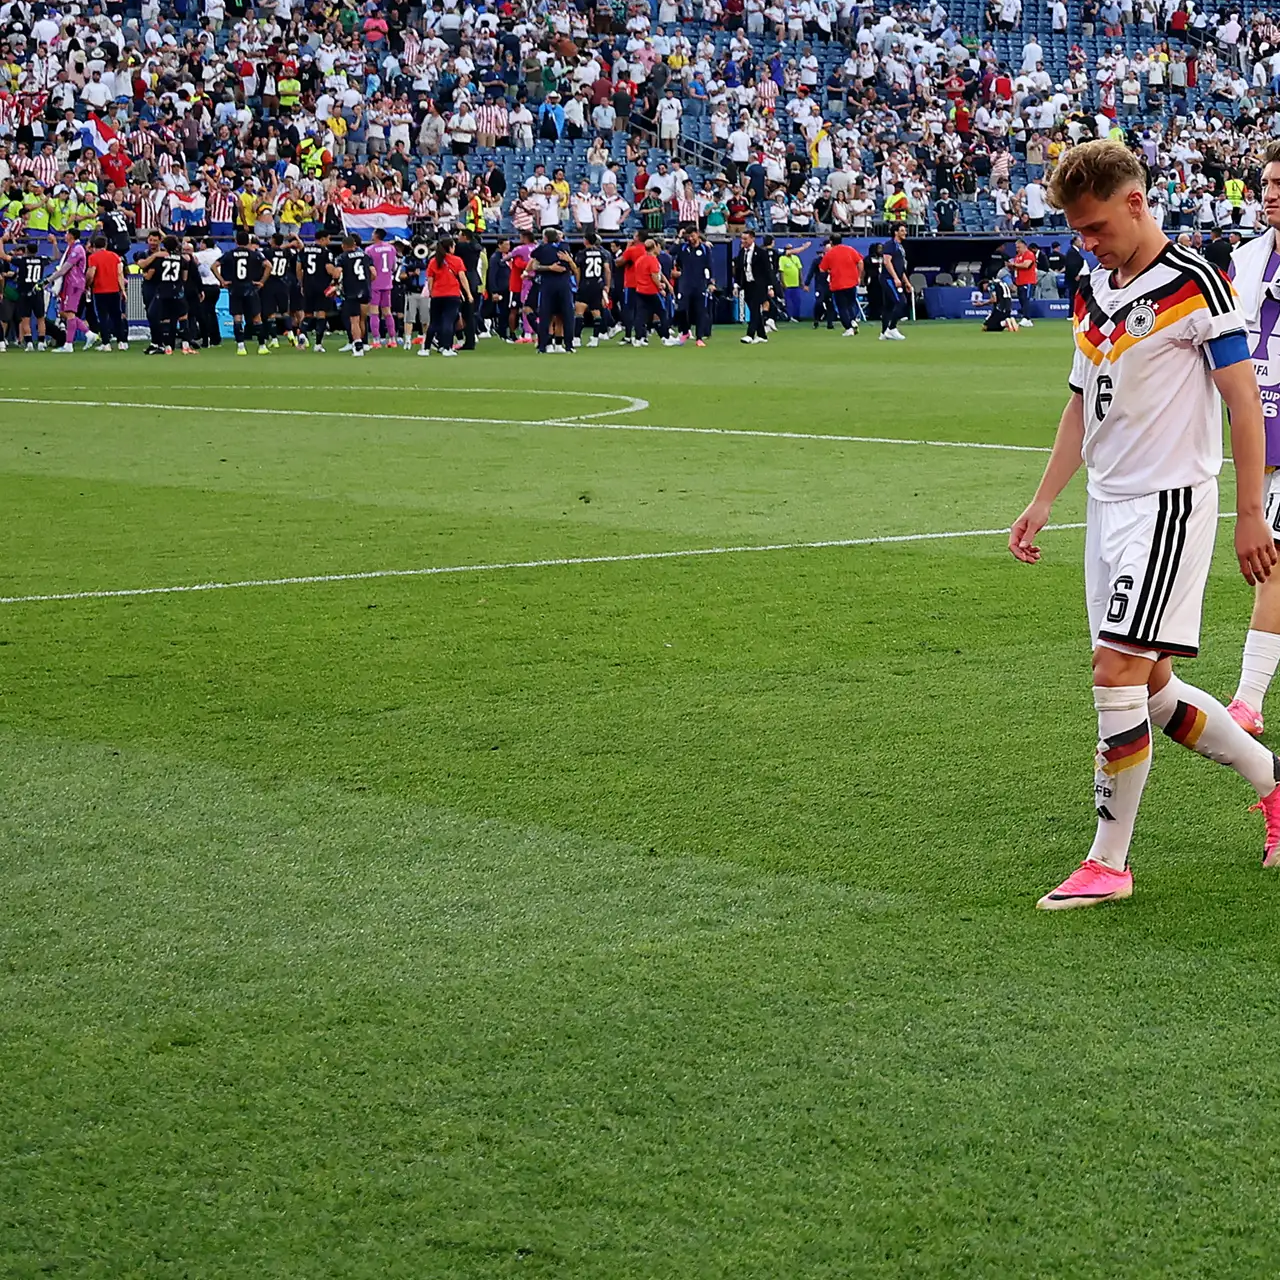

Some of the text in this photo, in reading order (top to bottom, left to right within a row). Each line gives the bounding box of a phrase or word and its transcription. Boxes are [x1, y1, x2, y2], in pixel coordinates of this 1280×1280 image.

[111, 214, 128, 232] 15
[161, 260, 181, 281] 23
[236, 258, 248, 280] 6
[270, 257, 287, 276] 18
[307, 254, 316, 274] 5
[353, 258, 366, 280] 4
[381, 253, 389, 272] 1
[585, 257, 602, 278] 26
[25, 264, 41, 283] 10
[1095, 375, 1114, 422] 6
[1260, 389, 1280, 402] CUP
[1106, 574, 1134, 623] 6
[1094, 784, 1113, 798] FB
